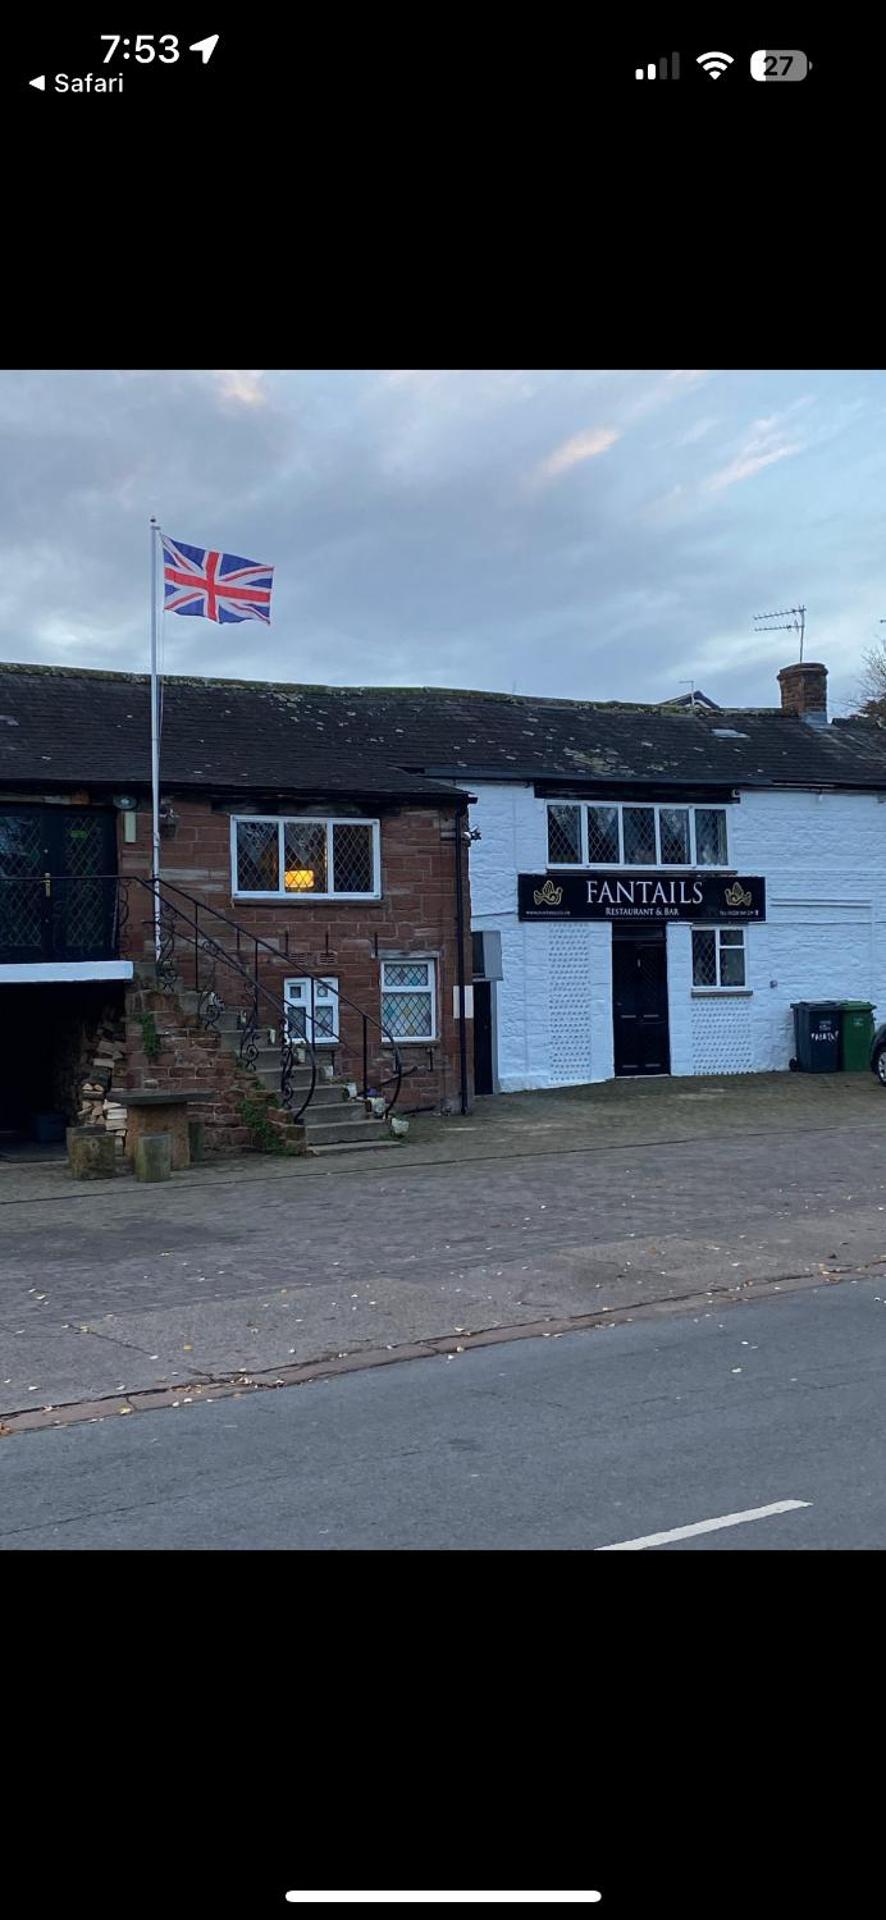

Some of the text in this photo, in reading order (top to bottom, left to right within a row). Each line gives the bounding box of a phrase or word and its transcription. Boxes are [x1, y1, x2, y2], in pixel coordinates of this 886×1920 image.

[586, 880, 703, 904] FANTAILS
[655, 907, 663, 916] &
[664, 907, 680, 916] BAR
